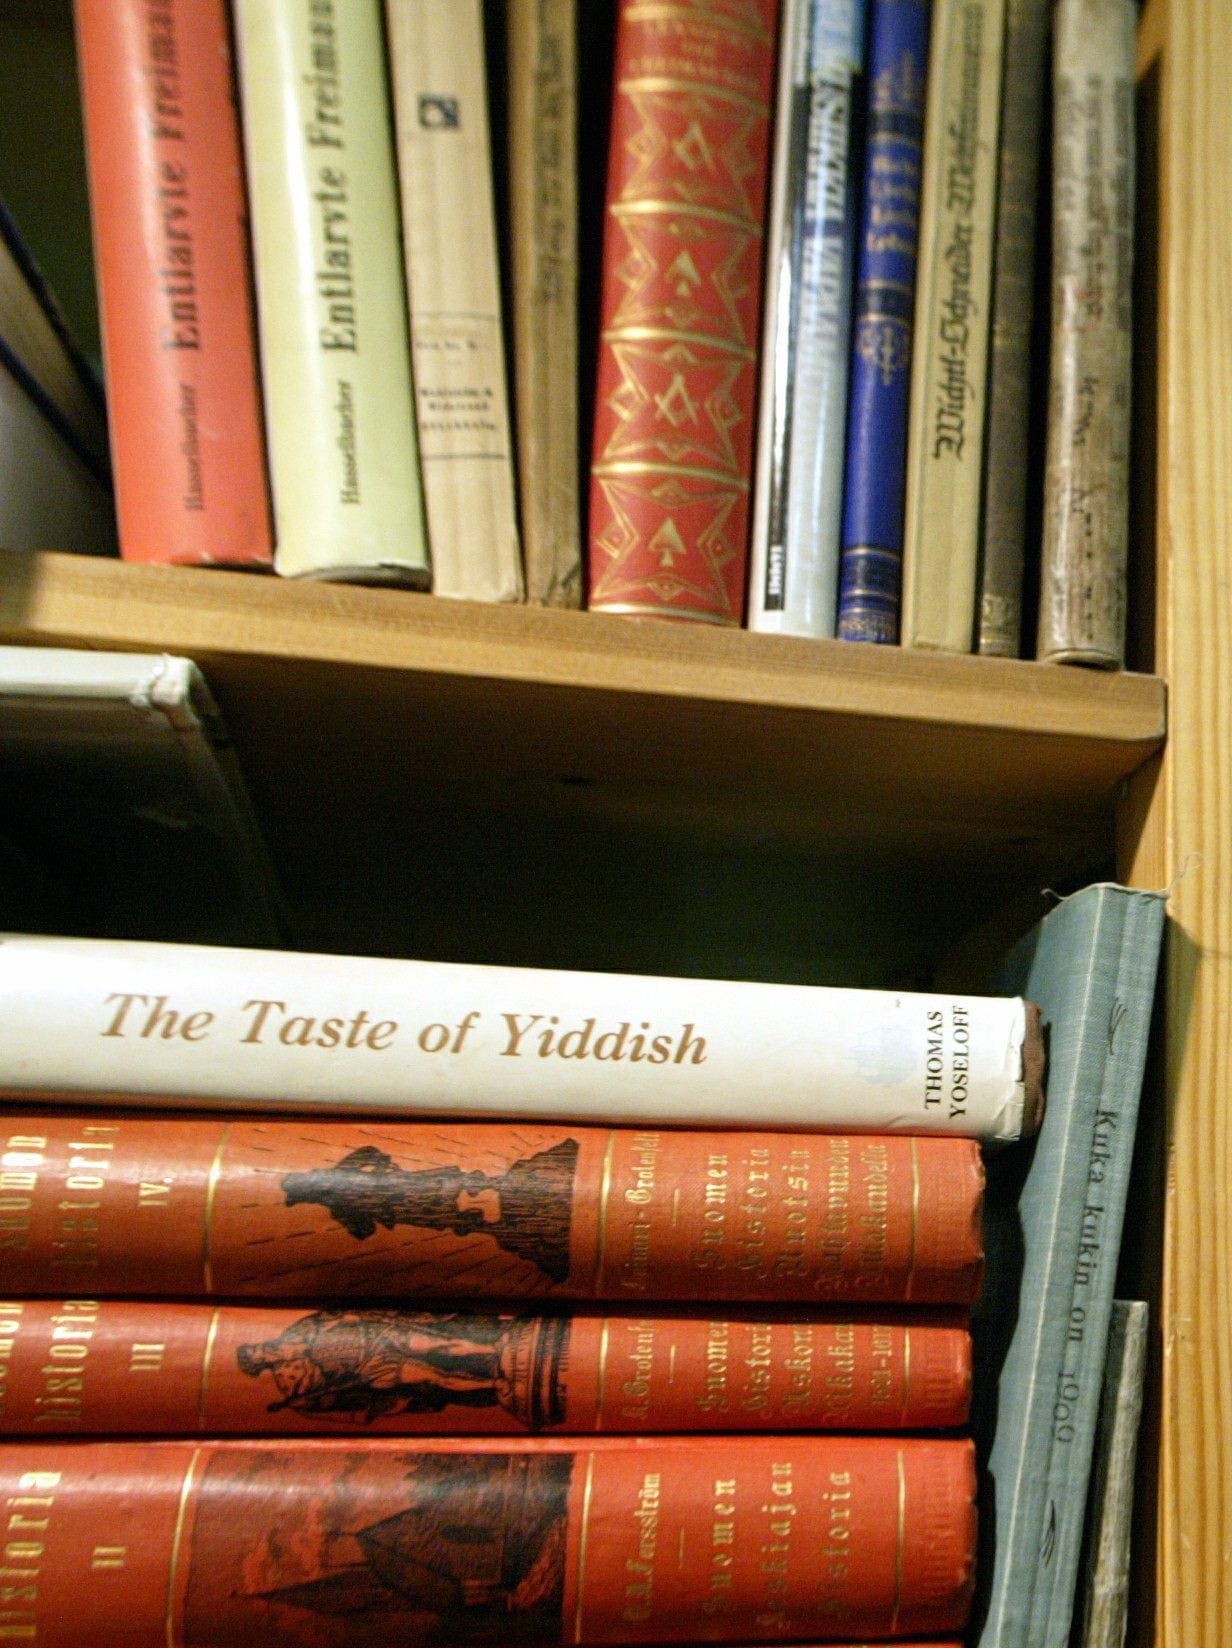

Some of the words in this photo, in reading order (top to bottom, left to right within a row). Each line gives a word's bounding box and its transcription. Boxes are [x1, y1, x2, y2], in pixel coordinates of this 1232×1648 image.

[161, 163, 202, 353] Entlarvte
[317, 174, 359, 354] Entlarvte
[100, 992, 214, 1042] The
[238, 998, 400, 1051] Taste
[416, 1012, 482, 1055] of
[500, 1013, 709, 1067] Yiddish
[922, 1010, 944, 1110] THOMAS
[948, 1004, 971, 1120] YOSELOFF
[1089, 1108, 1118, 1187] Kuka
[1072, 1203, 1102, 1288] kukin
[34, 1299, 101, 1422] historia
[128, 1342, 165, 1372] III
[623, 1322, 658, 1397] Grotenf
[1066, 1306, 1087, 1342] on
